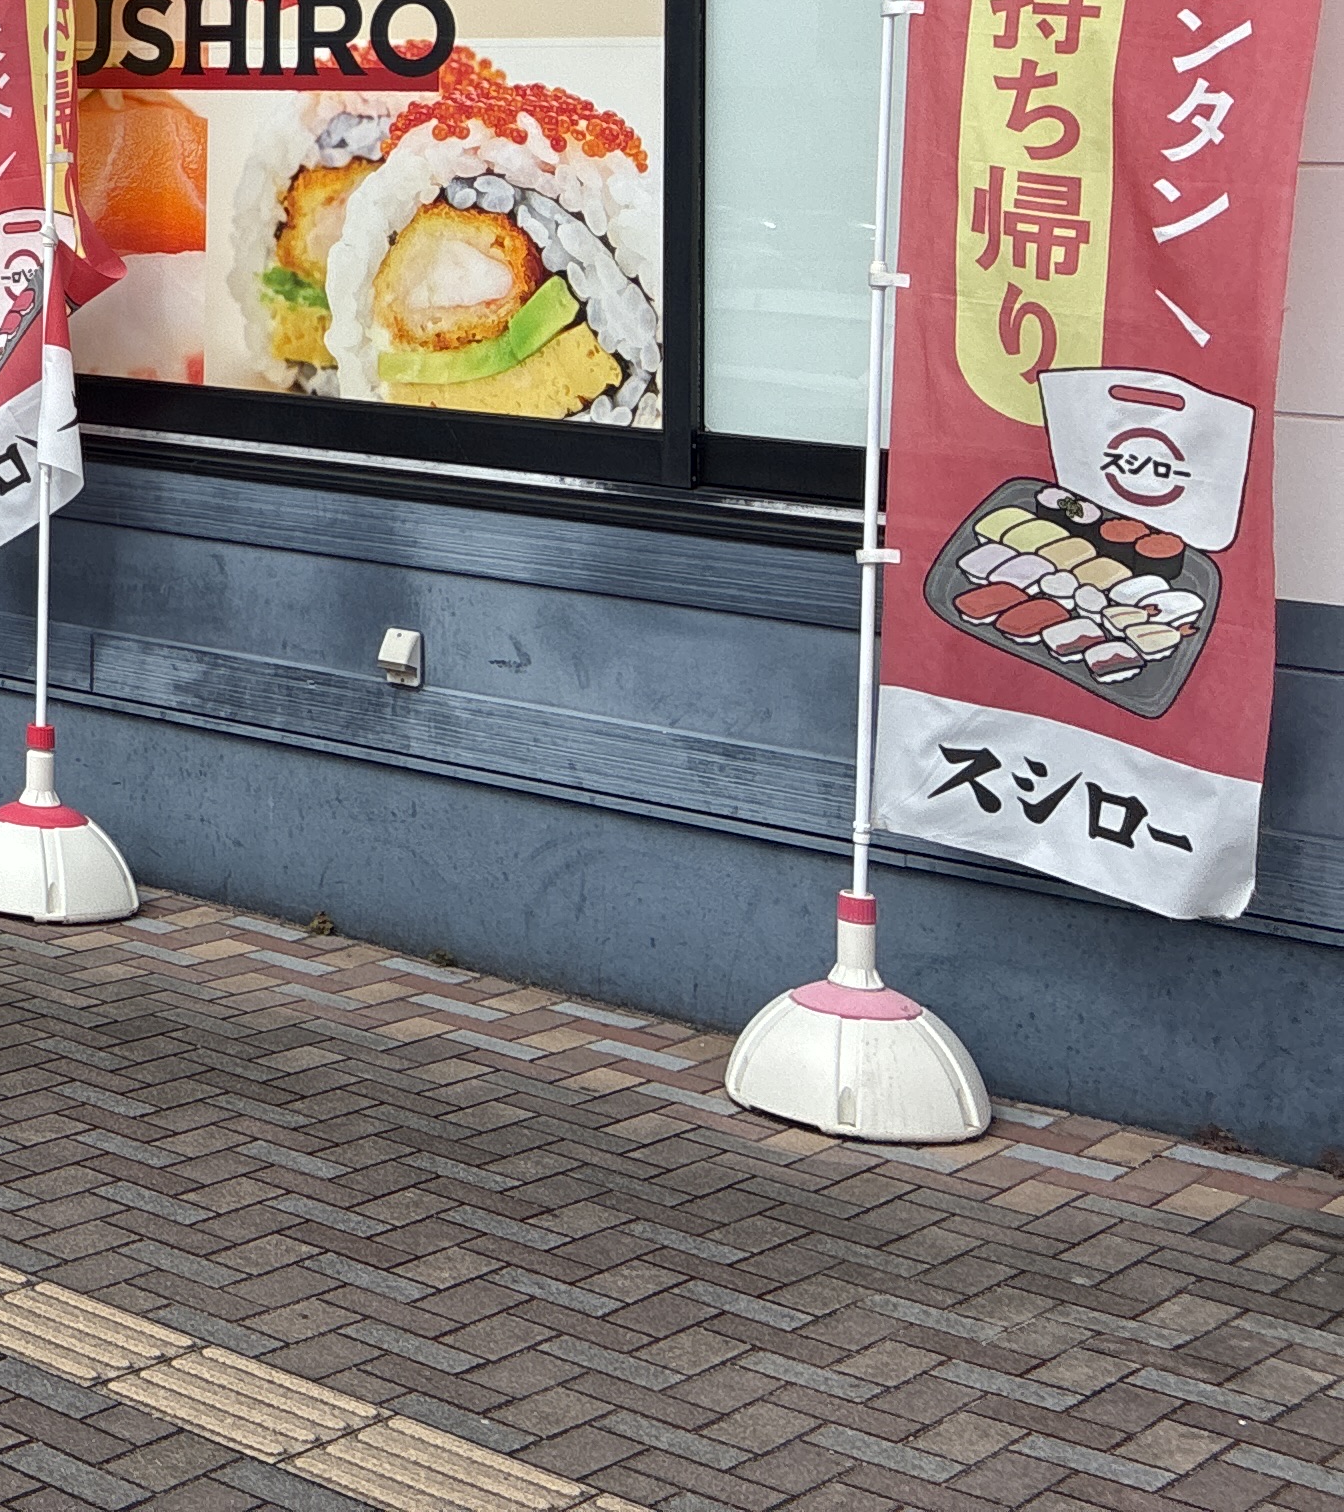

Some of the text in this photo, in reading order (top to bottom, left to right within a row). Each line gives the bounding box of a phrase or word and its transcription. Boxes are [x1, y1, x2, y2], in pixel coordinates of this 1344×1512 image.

[1099, 452, 1191, 479] スシロー
[928, 743, 1193, 853] スシロー
